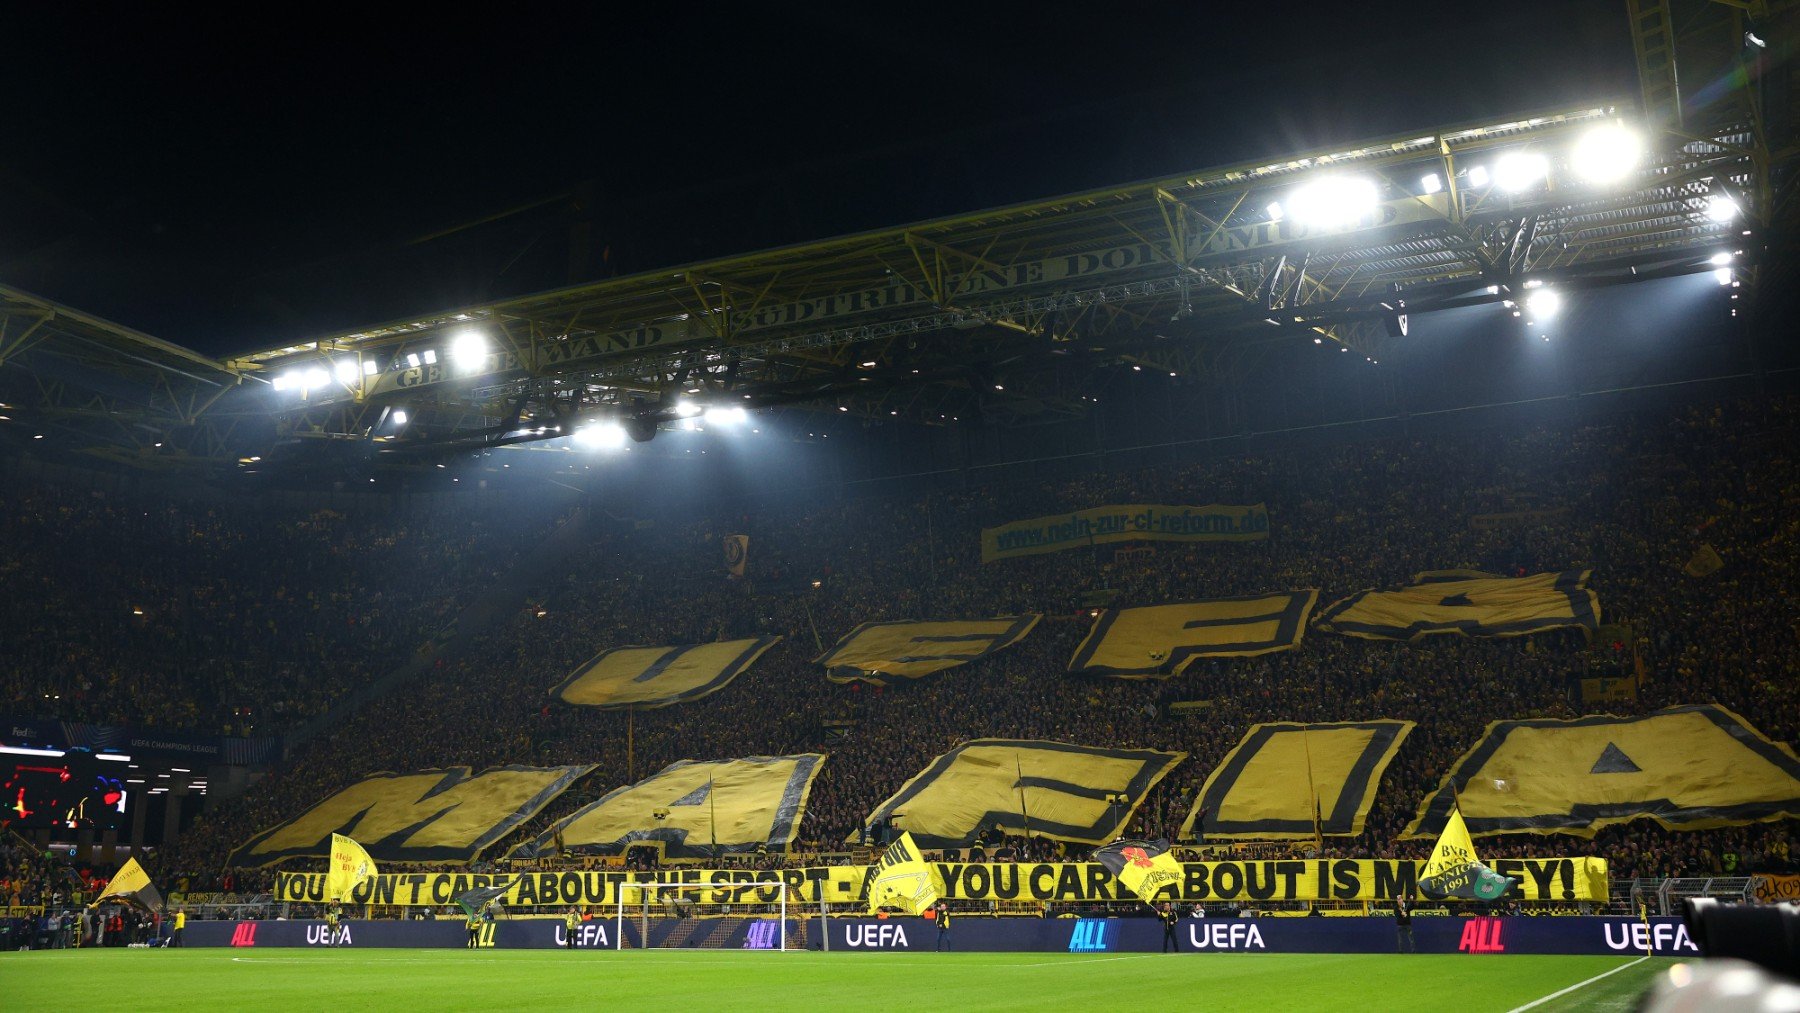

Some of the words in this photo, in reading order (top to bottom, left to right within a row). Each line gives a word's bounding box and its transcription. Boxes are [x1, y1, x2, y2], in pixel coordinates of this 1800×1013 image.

[545, 327, 662, 362] WAND
[732, 262, 1043, 329] SÜDTRIBÜNE
[1064, 204, 1397, 276] DORTMUD
[996, 509, 1267, 550] www.nein-zur-cl-reform.de
[131, 739, 150, 748] UEFA
[151, 740, 191, 751] CHAMPIONS
[192, 744, 218, 753] LEAGUE
[276, 873, 326, 901] YOU
[350, 875, 426, 904] ON'T
[517, 872, 626, 904] ABOUT
[634, 870, 701, 904] THE
[711, 868, 829, 903] SPORT
[937, 864, 1019, 899] YOU
[1317, 859, 1361, 900] IS
[1373, 859, 1575, 900] MEY!
[1443, 875, 1469, 894] 1991
[231, 921, 257, 947] ALL
[468, 921, 496, 947] LL
[845, 924, 908, 947] UEFA
[1068, 919, 1106, 951] ALL
[1190, 923, 1266, 948] UEFA
[1459, 917, 1505, 952] ALL
[1603, 923, 1699, 951] UEFA
